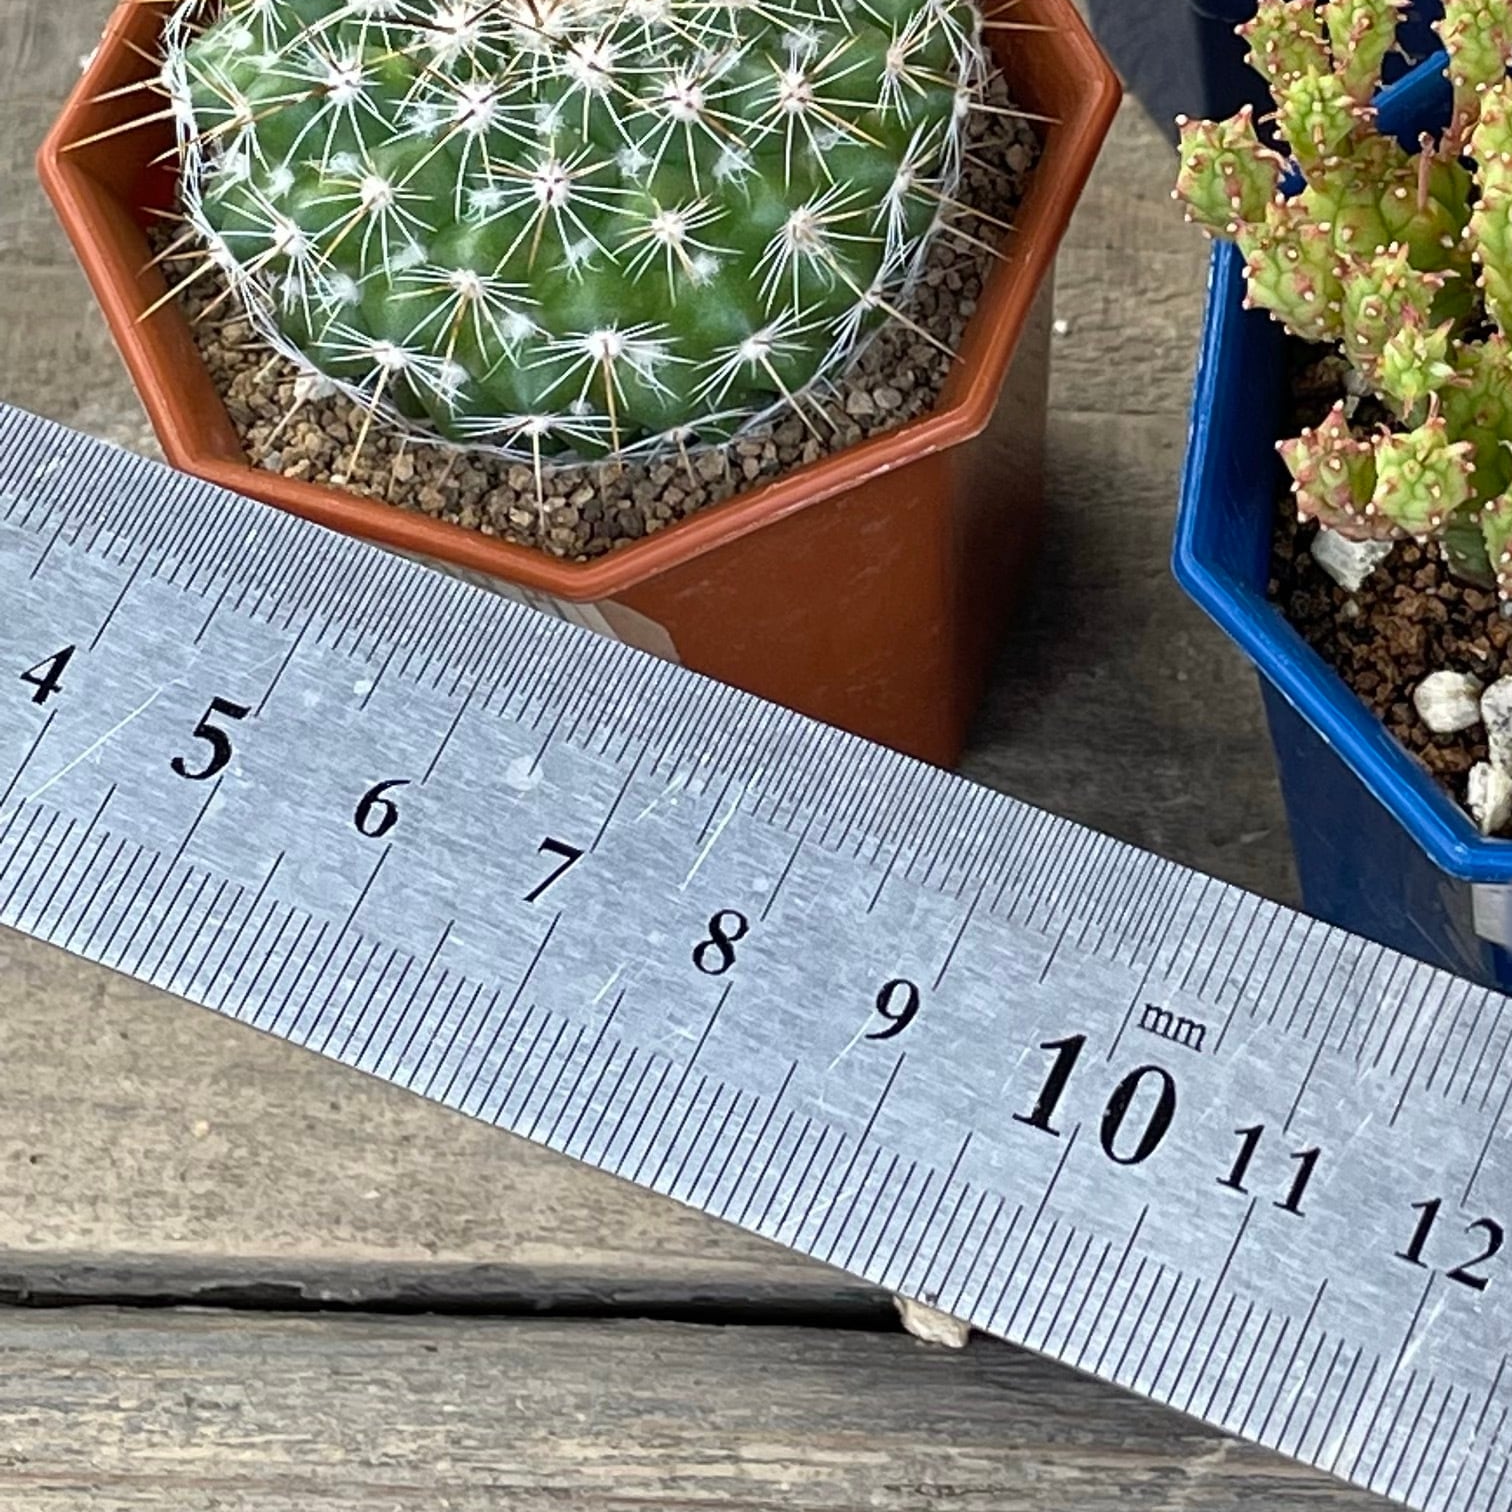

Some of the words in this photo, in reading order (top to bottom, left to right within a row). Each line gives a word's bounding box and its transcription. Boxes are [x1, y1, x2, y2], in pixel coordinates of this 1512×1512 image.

[20, 644, 76, 705] 4
[171, 696, 252, 781] 5
[353, 779, 411, 839] 6
[522, 837, 585, 903] 7
[692, 909, 749, 975] 8
[865, 979, 920, 1040] 9
[1012, 1033, 1177, 1165] 10
[1216, 1123, 1323, 1217] 11
[1394, 1198, 1504, 1291] 12
[1136, 1001, 1207, 1051] mm
